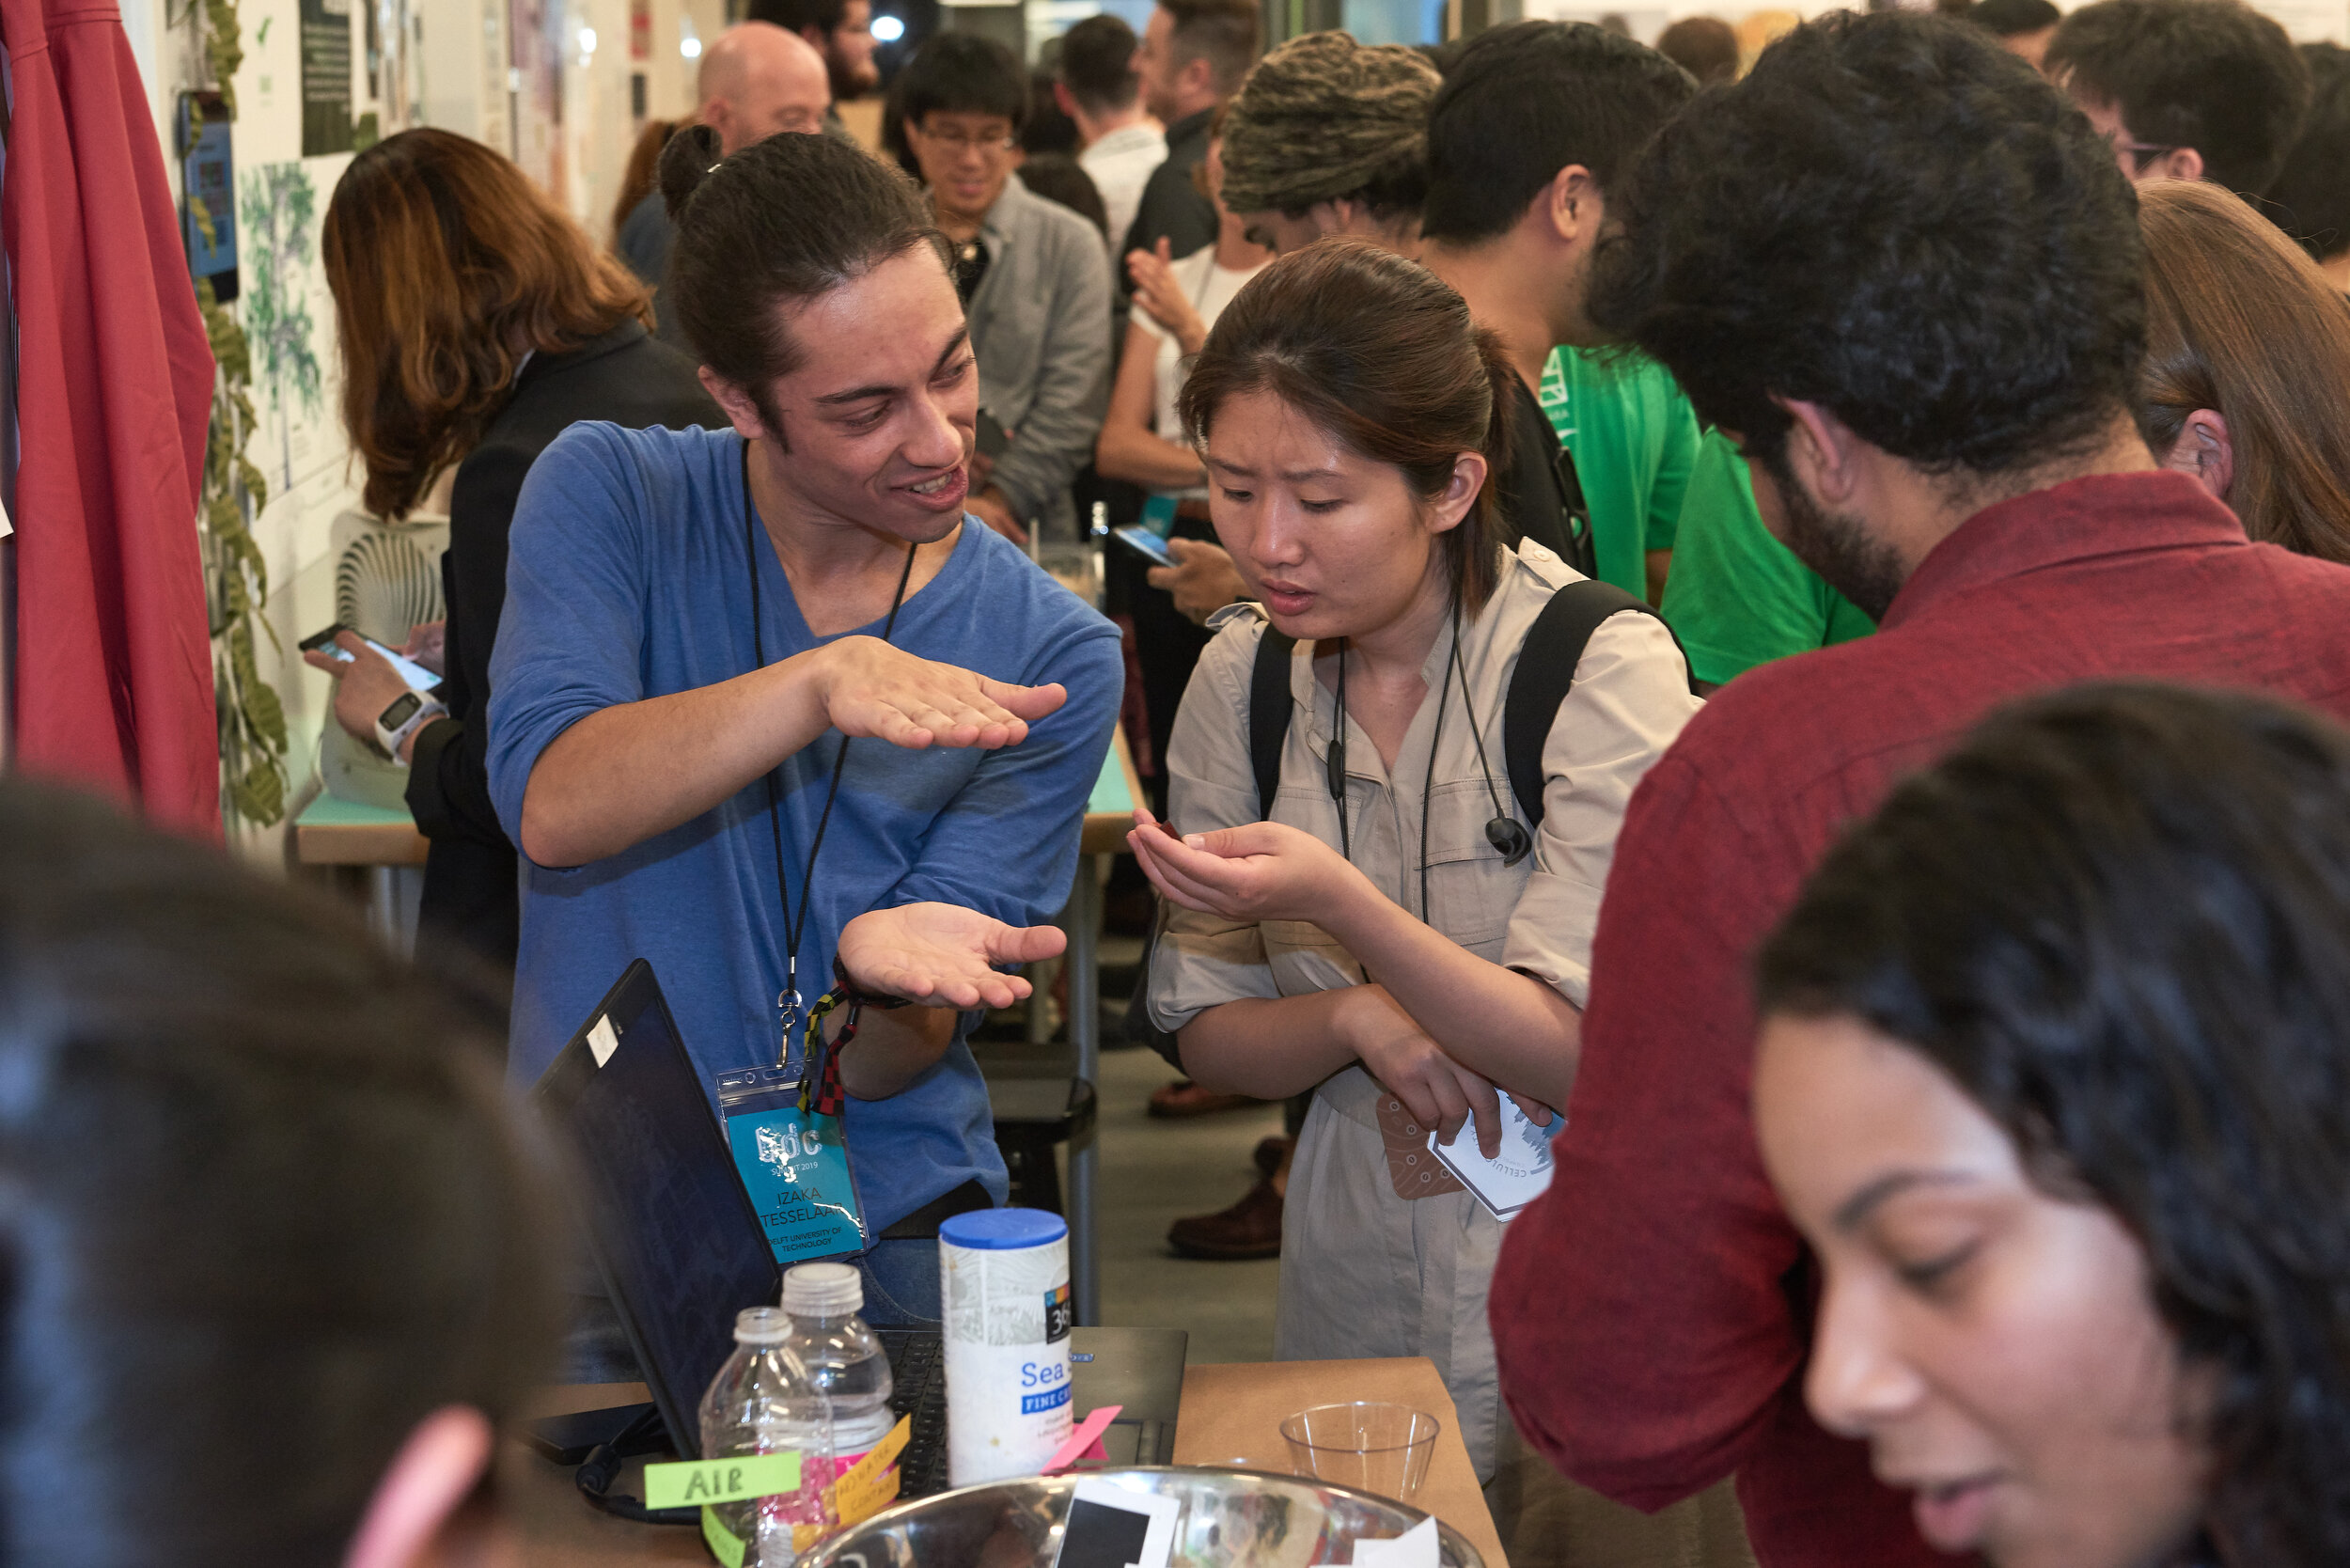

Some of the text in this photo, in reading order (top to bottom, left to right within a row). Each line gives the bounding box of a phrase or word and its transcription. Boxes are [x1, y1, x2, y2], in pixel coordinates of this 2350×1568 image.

[802, 1161, 819, 1173] 2019
[777, 1187, 822, 1205] IZAKA
[790, 1229, 831, 1242] UNIVERSITY
[831, 1226, 842, 1234] OF
[782, 1237, 832, 1252] TECHNOLOGY
[1021, 1362, 1064, 1388] Sea
[1026, 1393, 1056, 1411] FINE
[684, 1466, 744, 1501] AIR
